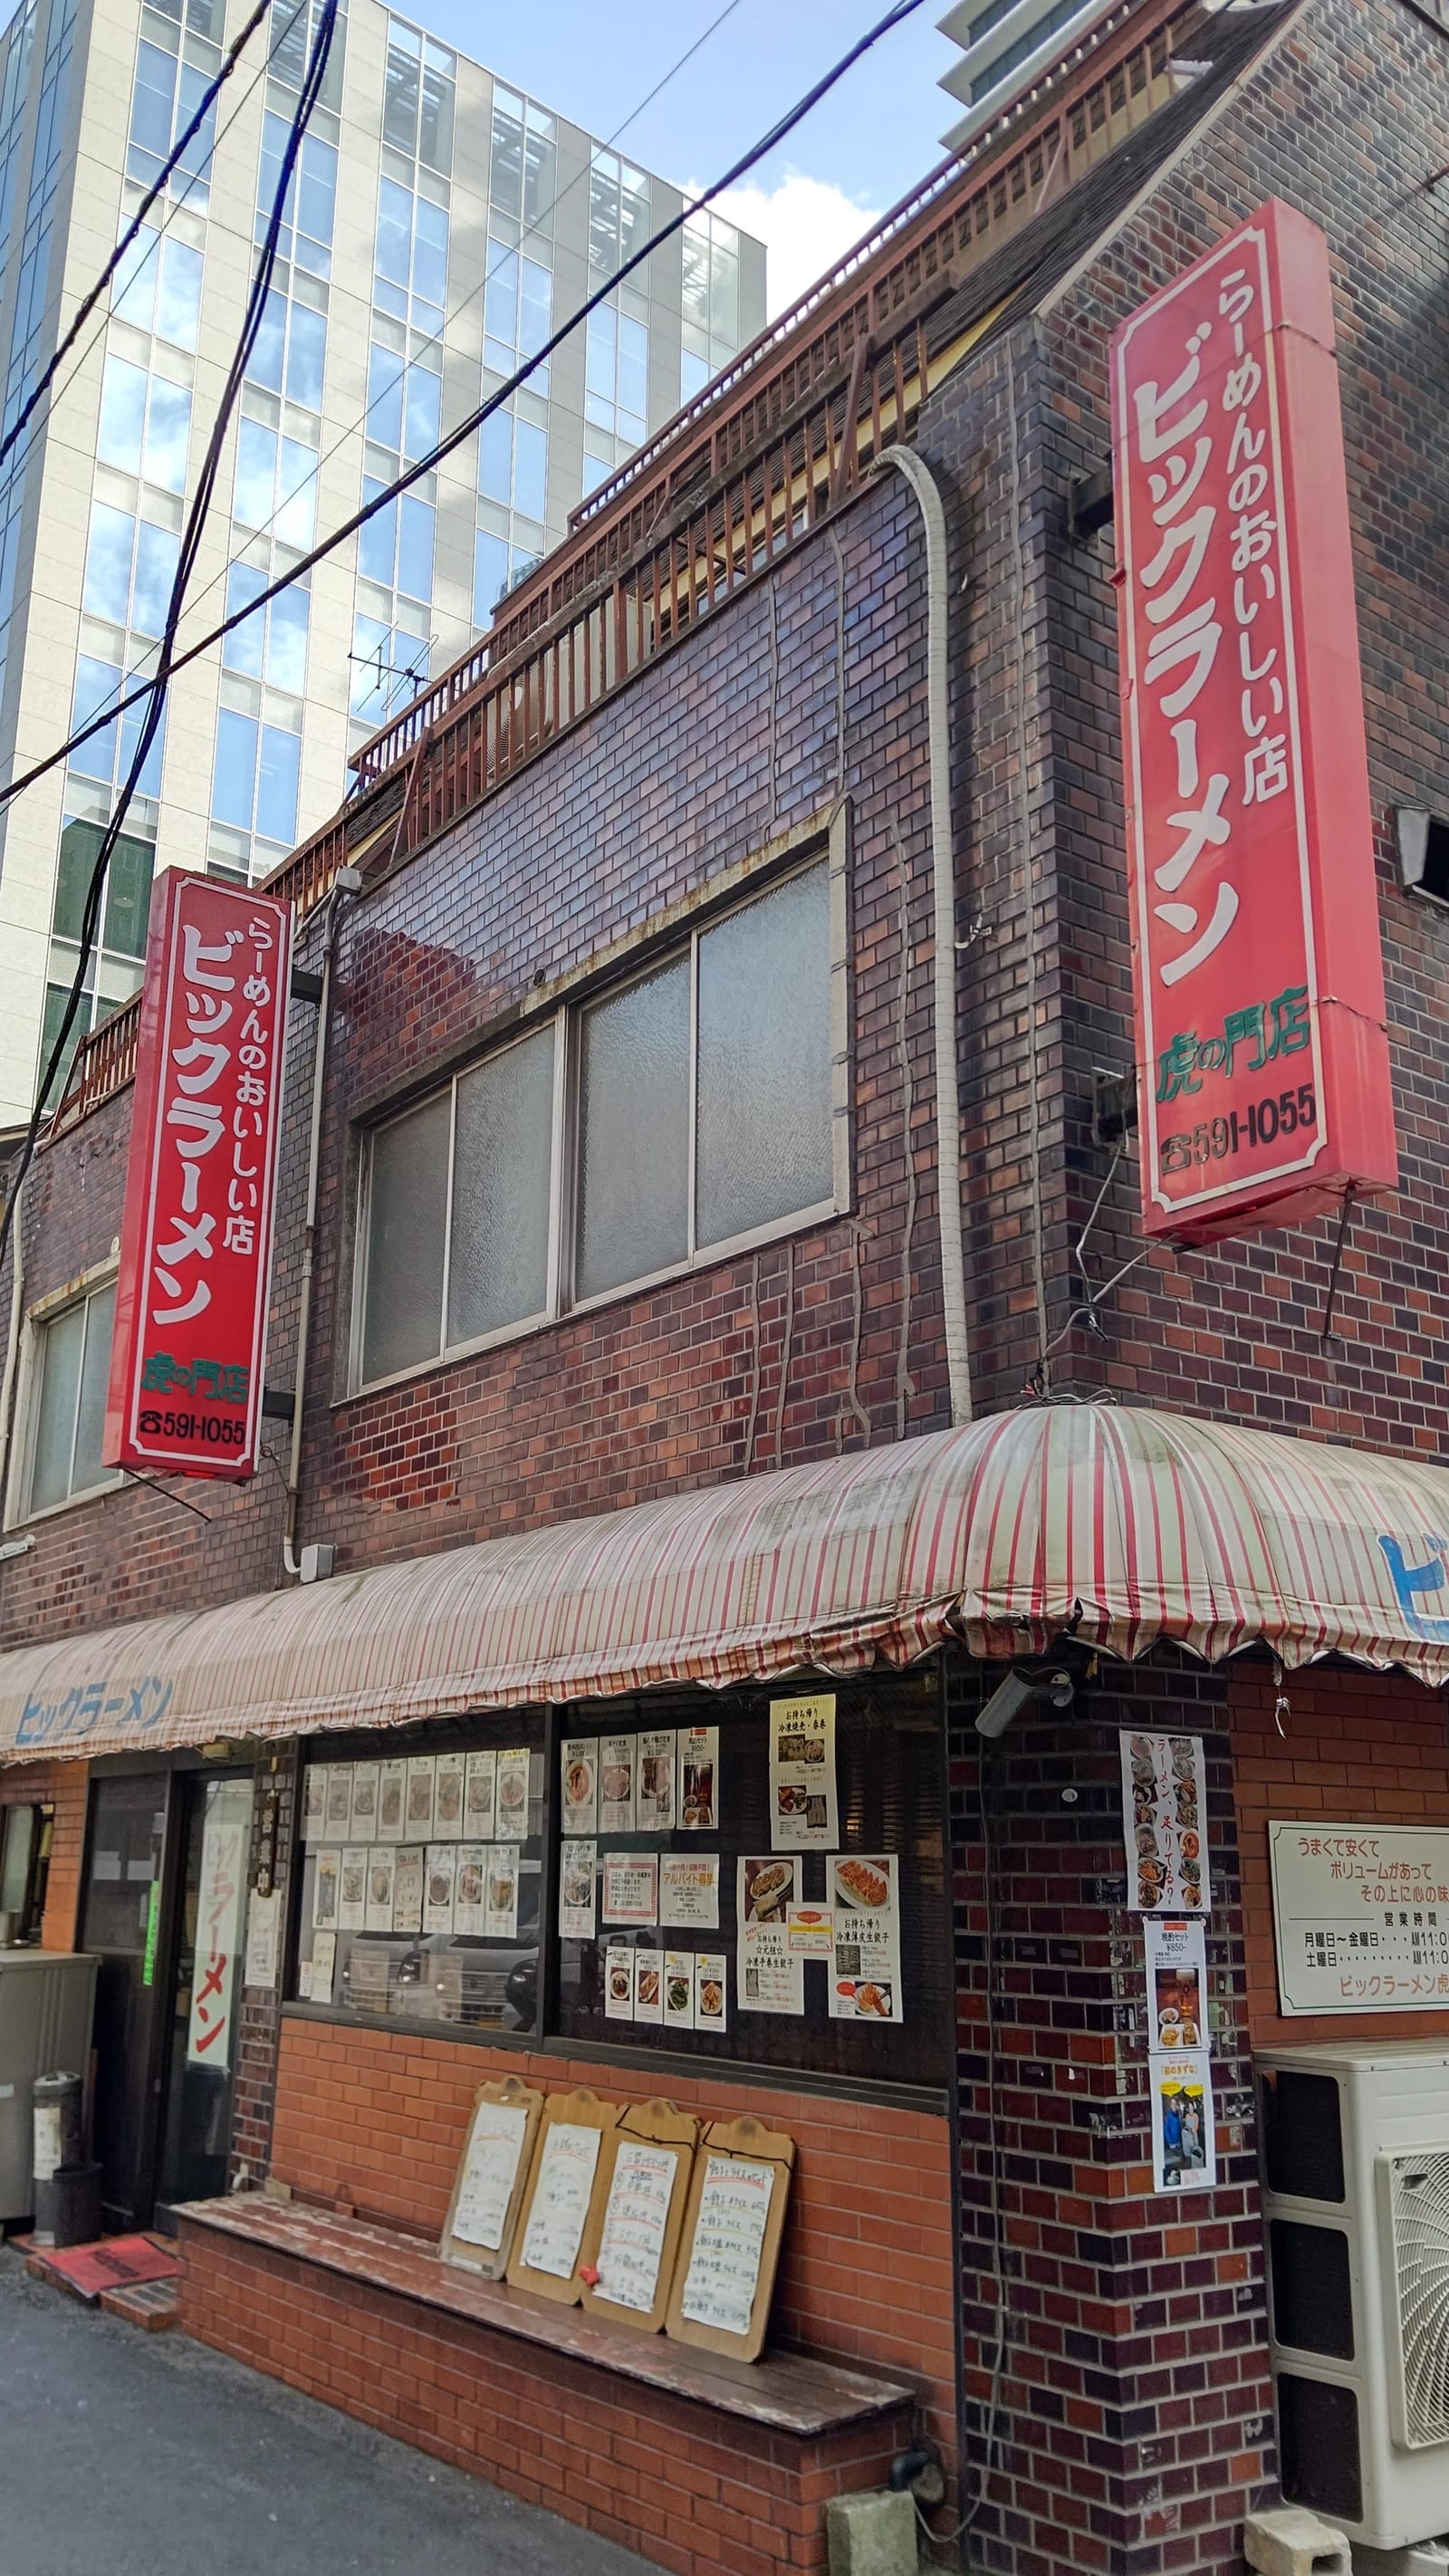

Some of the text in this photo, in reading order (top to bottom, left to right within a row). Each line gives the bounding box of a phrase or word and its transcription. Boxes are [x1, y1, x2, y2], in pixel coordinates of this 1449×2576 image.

[1219, 268, 1289, 806] らーめんのおいしい店
[1133, 322, 1240, 987] ビックラーメン
[1156, 985, 1310, 1102] 虎の門店
[223, 917, 273, 1256] らーめんのおいしい店
[152, 924, 245, 1326] ビックラーメン
[142, 1350, 248, 1403] 虎の門店
[15, 1676, 173, 1745] ビックラーメン
[1298, 1837, 1380, 1858] うまくて安くて
[1330, 1860, 1433, 1880] ボリュームがあって
[1361, 1885, 1449, 1903] その上に心の味
[1384, 1911, 1438, 1927] 営業時間
